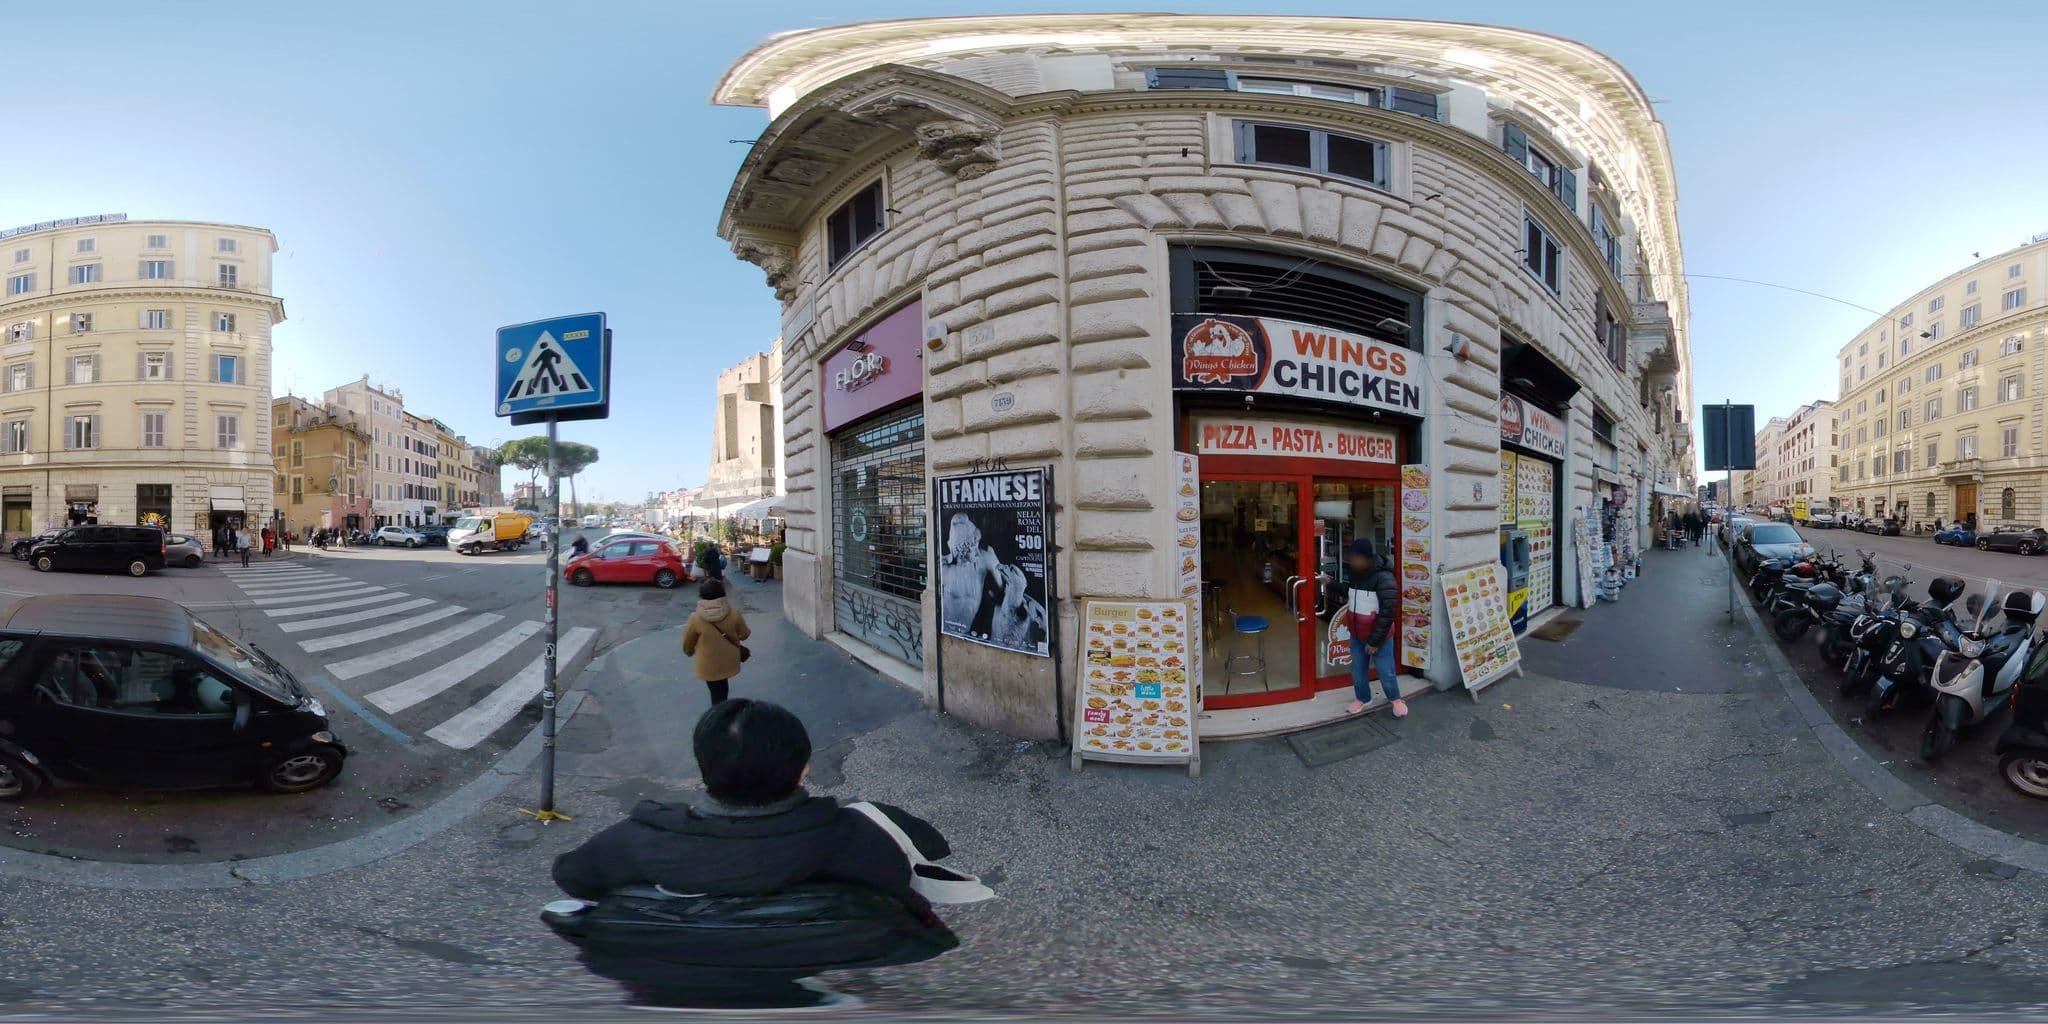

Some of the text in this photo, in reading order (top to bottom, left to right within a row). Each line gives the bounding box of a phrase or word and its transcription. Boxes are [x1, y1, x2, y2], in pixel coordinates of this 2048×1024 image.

[1188, 359, 1256, 371] Wings Chicken
[1291, 329, 1407, 376] WINGS
[1273, 359, 1420, 410] CHICKEN
[1203, 424, 1257, 449] PIZZA
[1272, 426, 1324, 453] PASTA
[1337, 432, 1393, 459] BURGER
[1525, 427, 1565, 456] CHICKEN
[942, 473, 1041, 503] I FARNESE
[1094, 607, 1129, 619] Burger
